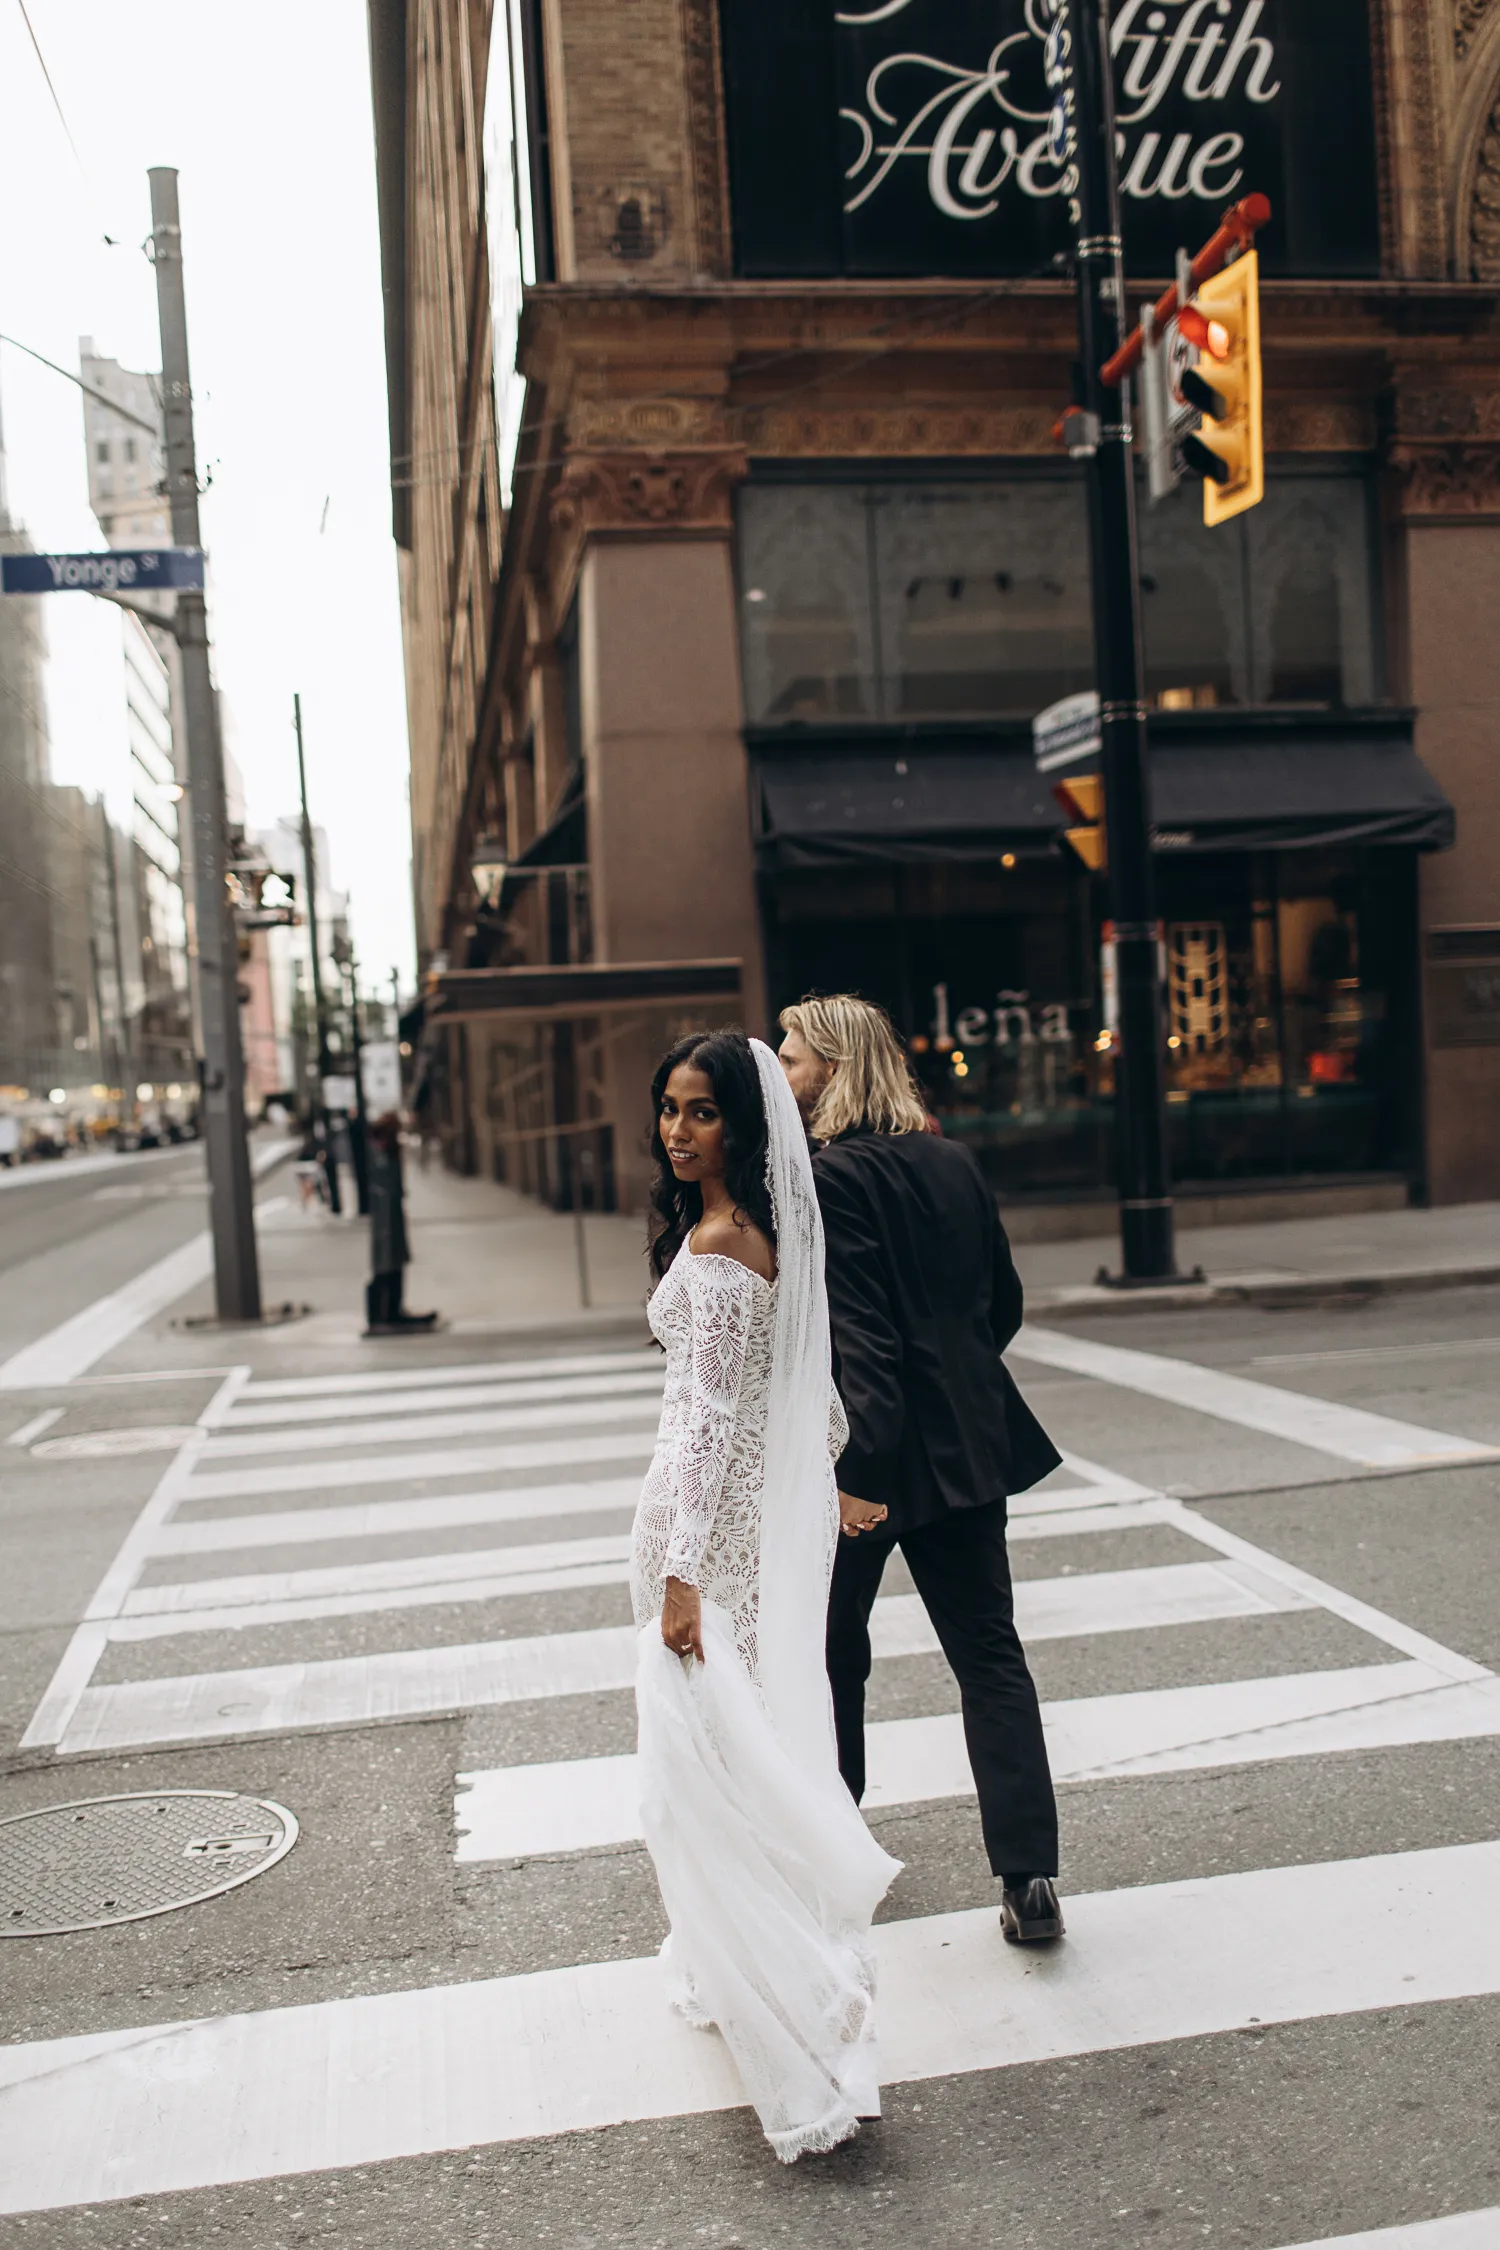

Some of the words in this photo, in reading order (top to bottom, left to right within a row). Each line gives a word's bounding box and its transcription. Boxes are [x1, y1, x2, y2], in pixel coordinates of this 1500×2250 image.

[838, 53, 1244, 219] Aveue
[47, 555, 137, 592] Yonge
[932, 982, 1076, 1047] leña
